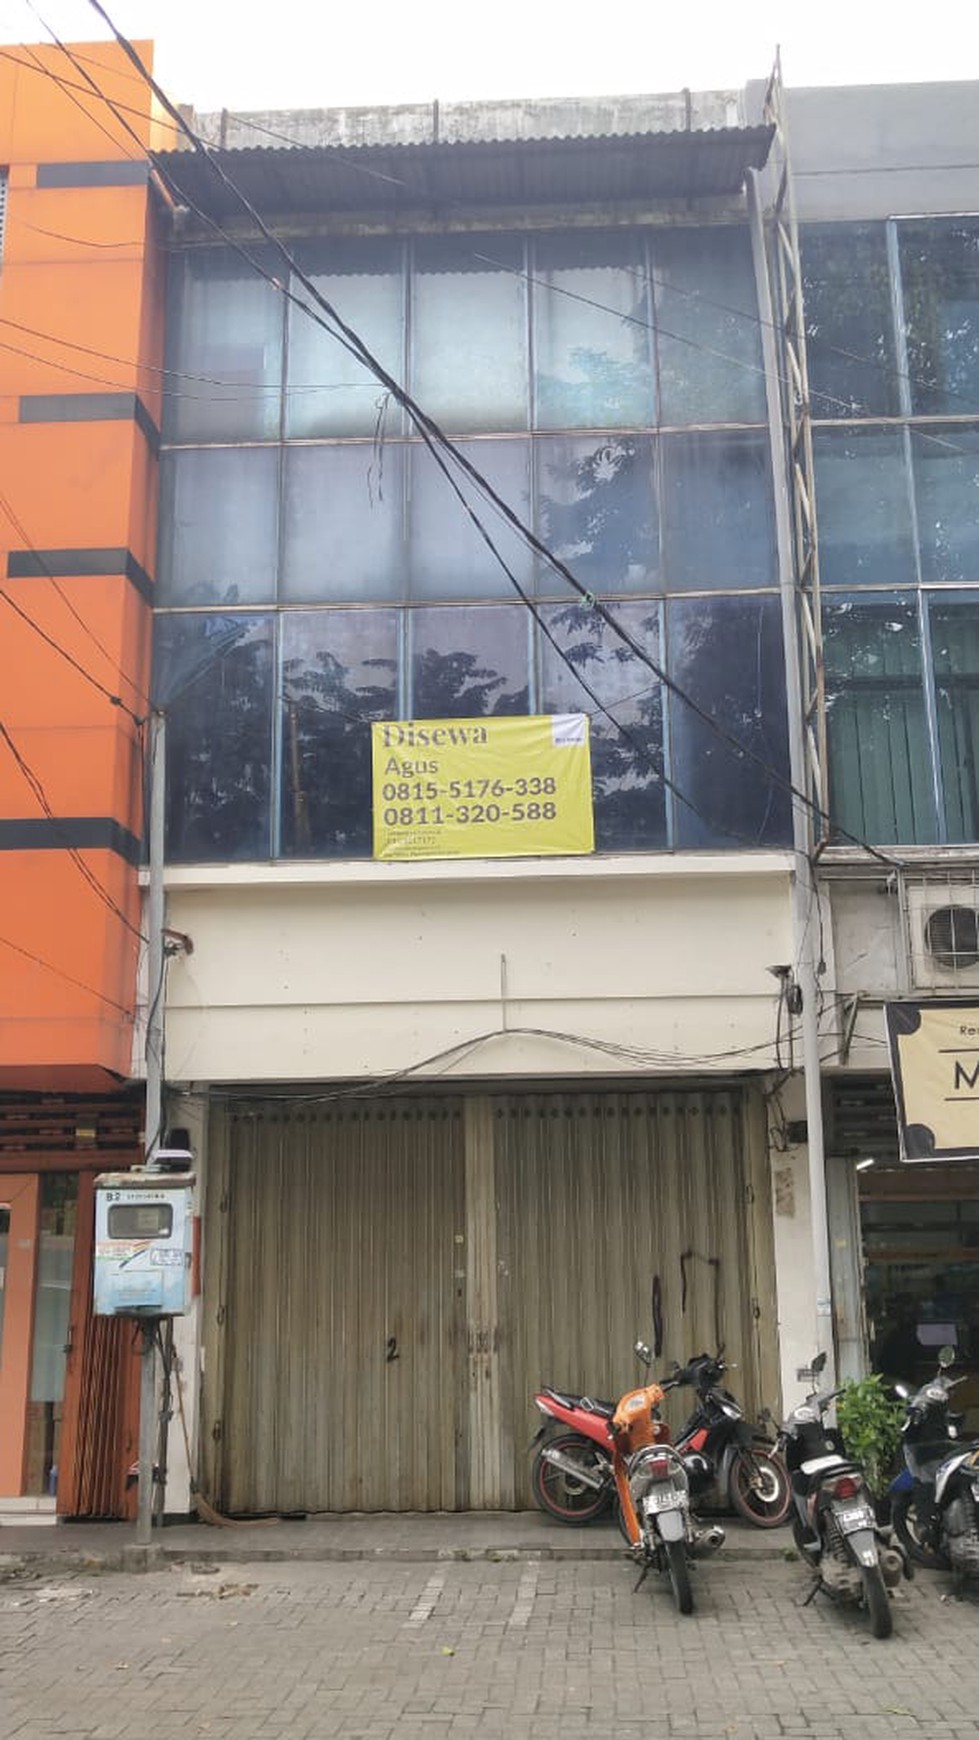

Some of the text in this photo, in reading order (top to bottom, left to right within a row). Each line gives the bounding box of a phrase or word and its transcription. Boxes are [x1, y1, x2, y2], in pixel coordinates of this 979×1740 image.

[382, 722, 488, 748] Disewa
[384, 757, 439, 778] Agus
[382, 777, 556, 801] 0815-5176-338
[384, 802, 557, 826] 0811-320-588
[960, 1025, 979, 1036] Re
